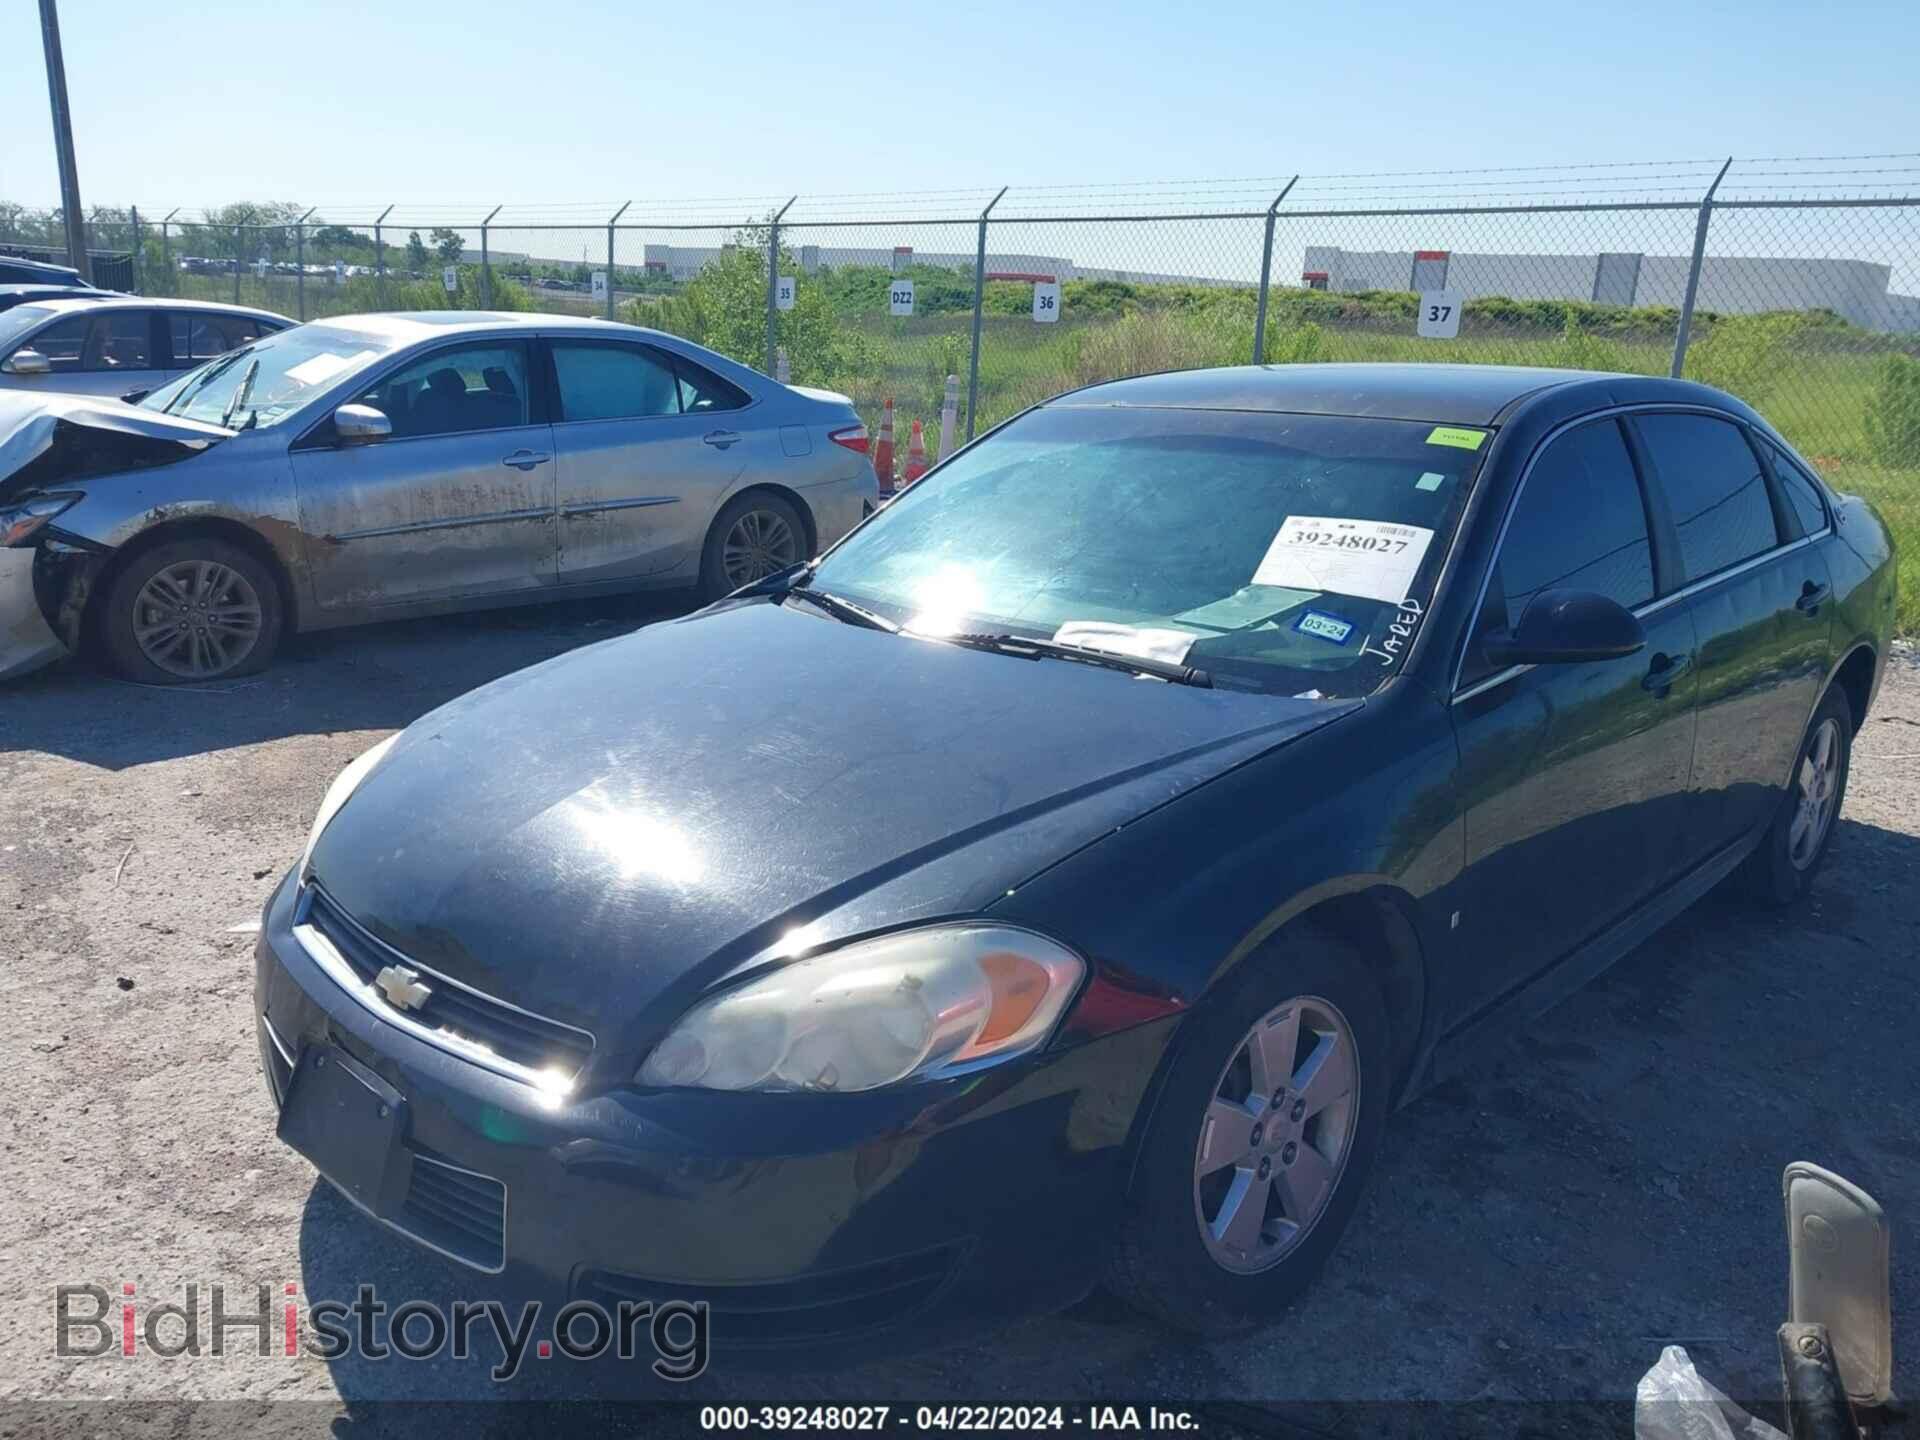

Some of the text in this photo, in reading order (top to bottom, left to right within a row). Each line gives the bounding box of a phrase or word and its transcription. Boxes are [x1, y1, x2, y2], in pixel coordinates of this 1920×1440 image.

[780, 287, 791, 300] 35
[892, 291, 912, 305] DZ2
[1039, 295, 1054, 310] 36
[1428, 305, 1452, 323] 37
[1288, 530, 1409, 555] 39248027
[1358, 598, 1423, 667] JARED
